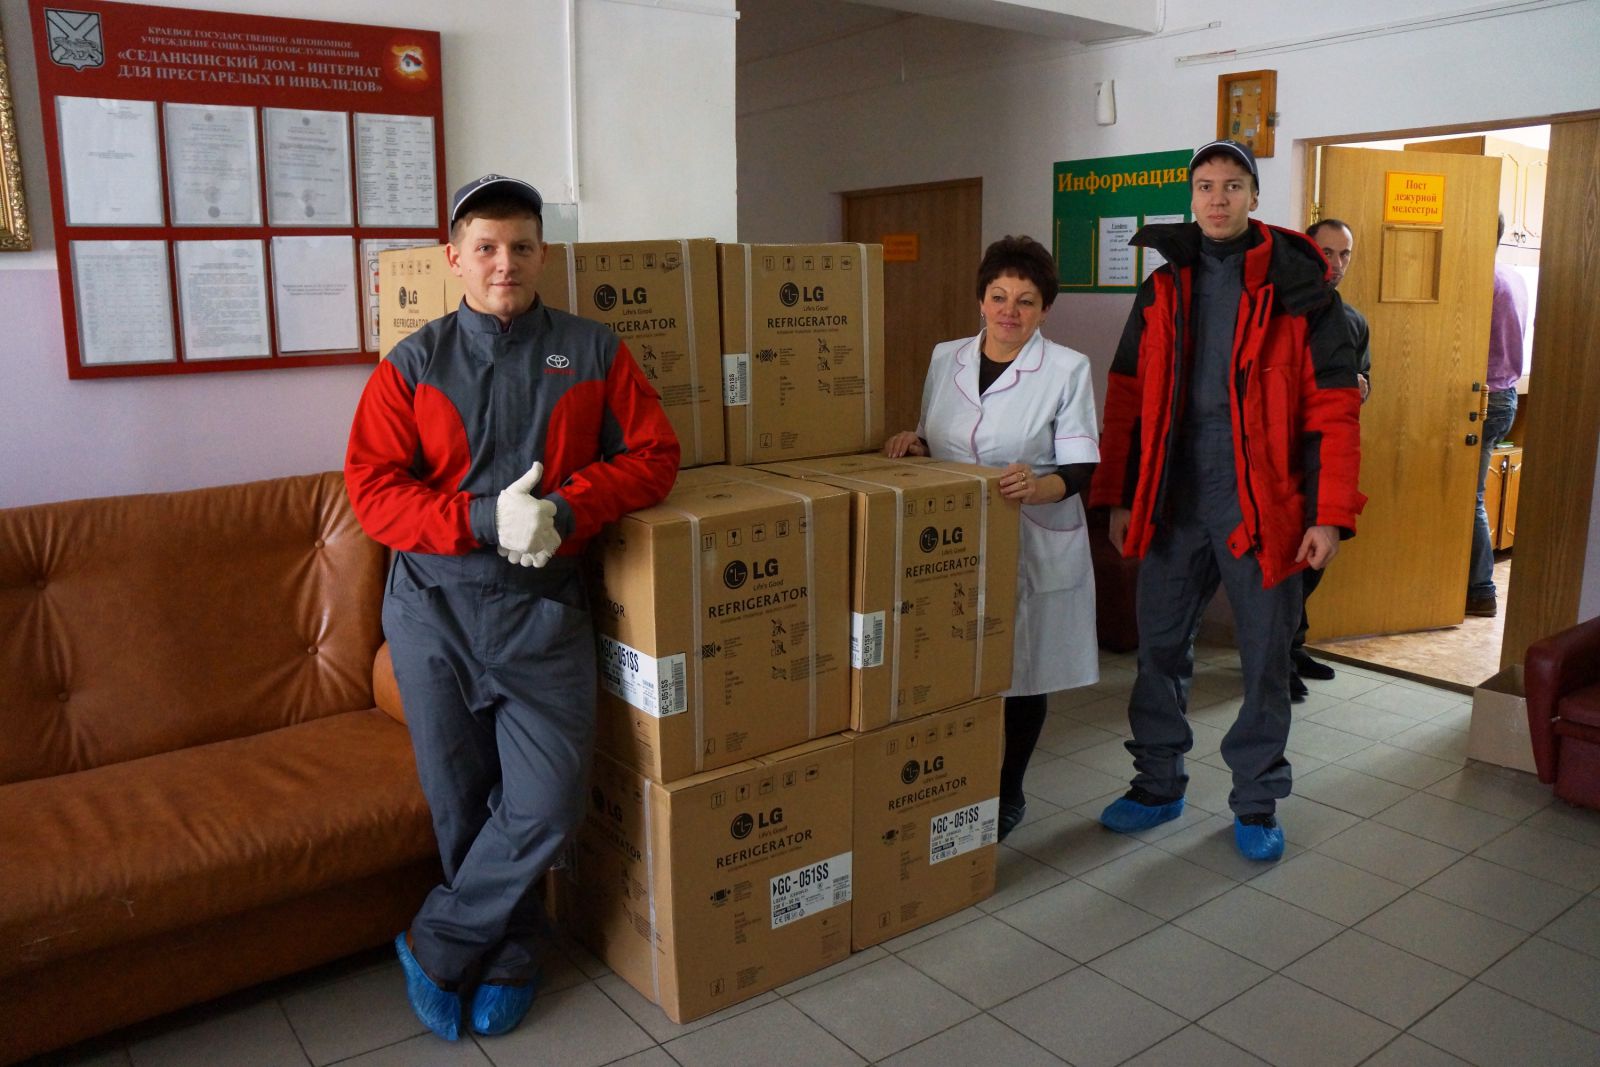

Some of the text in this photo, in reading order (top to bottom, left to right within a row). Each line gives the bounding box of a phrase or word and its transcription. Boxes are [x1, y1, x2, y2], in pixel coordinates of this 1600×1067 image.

[140, 36, 209, 48] УЧРЕЖДЕНИЕ
[211, 41, 283, 54] СОЦИАЛЬНОГО
[148, 26, 353, 49] КРАЕВОЕ ГОСУДАРСТВЕННОЕ АВТОНОМНОЕ
[117, 64, 152, 79] ДЛЯ
[156, 67, 271, 86] ПРЕСТАРЕЛЫХ
[275, 75, 286, 87] И
[262, 58, 296, 72] ДОМ
[307, 61, 381, 78] ИНТЕРНАТ
[1057, 166, 1190, 196] Информация
[1406, 179, 1427, 190] Пост
[1394, 193, 1437, 204] дежурной
[408, 290, 418, 305] LG
[622, 287, 647, 305] LG
[803, 286, 825, 303] LG
[393, 318, 429, 329] REFRIGERATO
[767, 314, 849, 329] REFRIGERATOR
[943, 526, 963, 546] LG
[753, 558, 779, 580] LG
[709, 586, 808, 619] REFRIGERATOR
[923, 755, 944, 775] LG
[888, 776, 967, 811] REFRIGERATOR
[759, 807, 783, 829] LG
[937, 806, 979, 834] GC-051SS
[715, 829, 813, 870] REFRIGERATOR
[777, 862, 829, 896] GC-051SS
